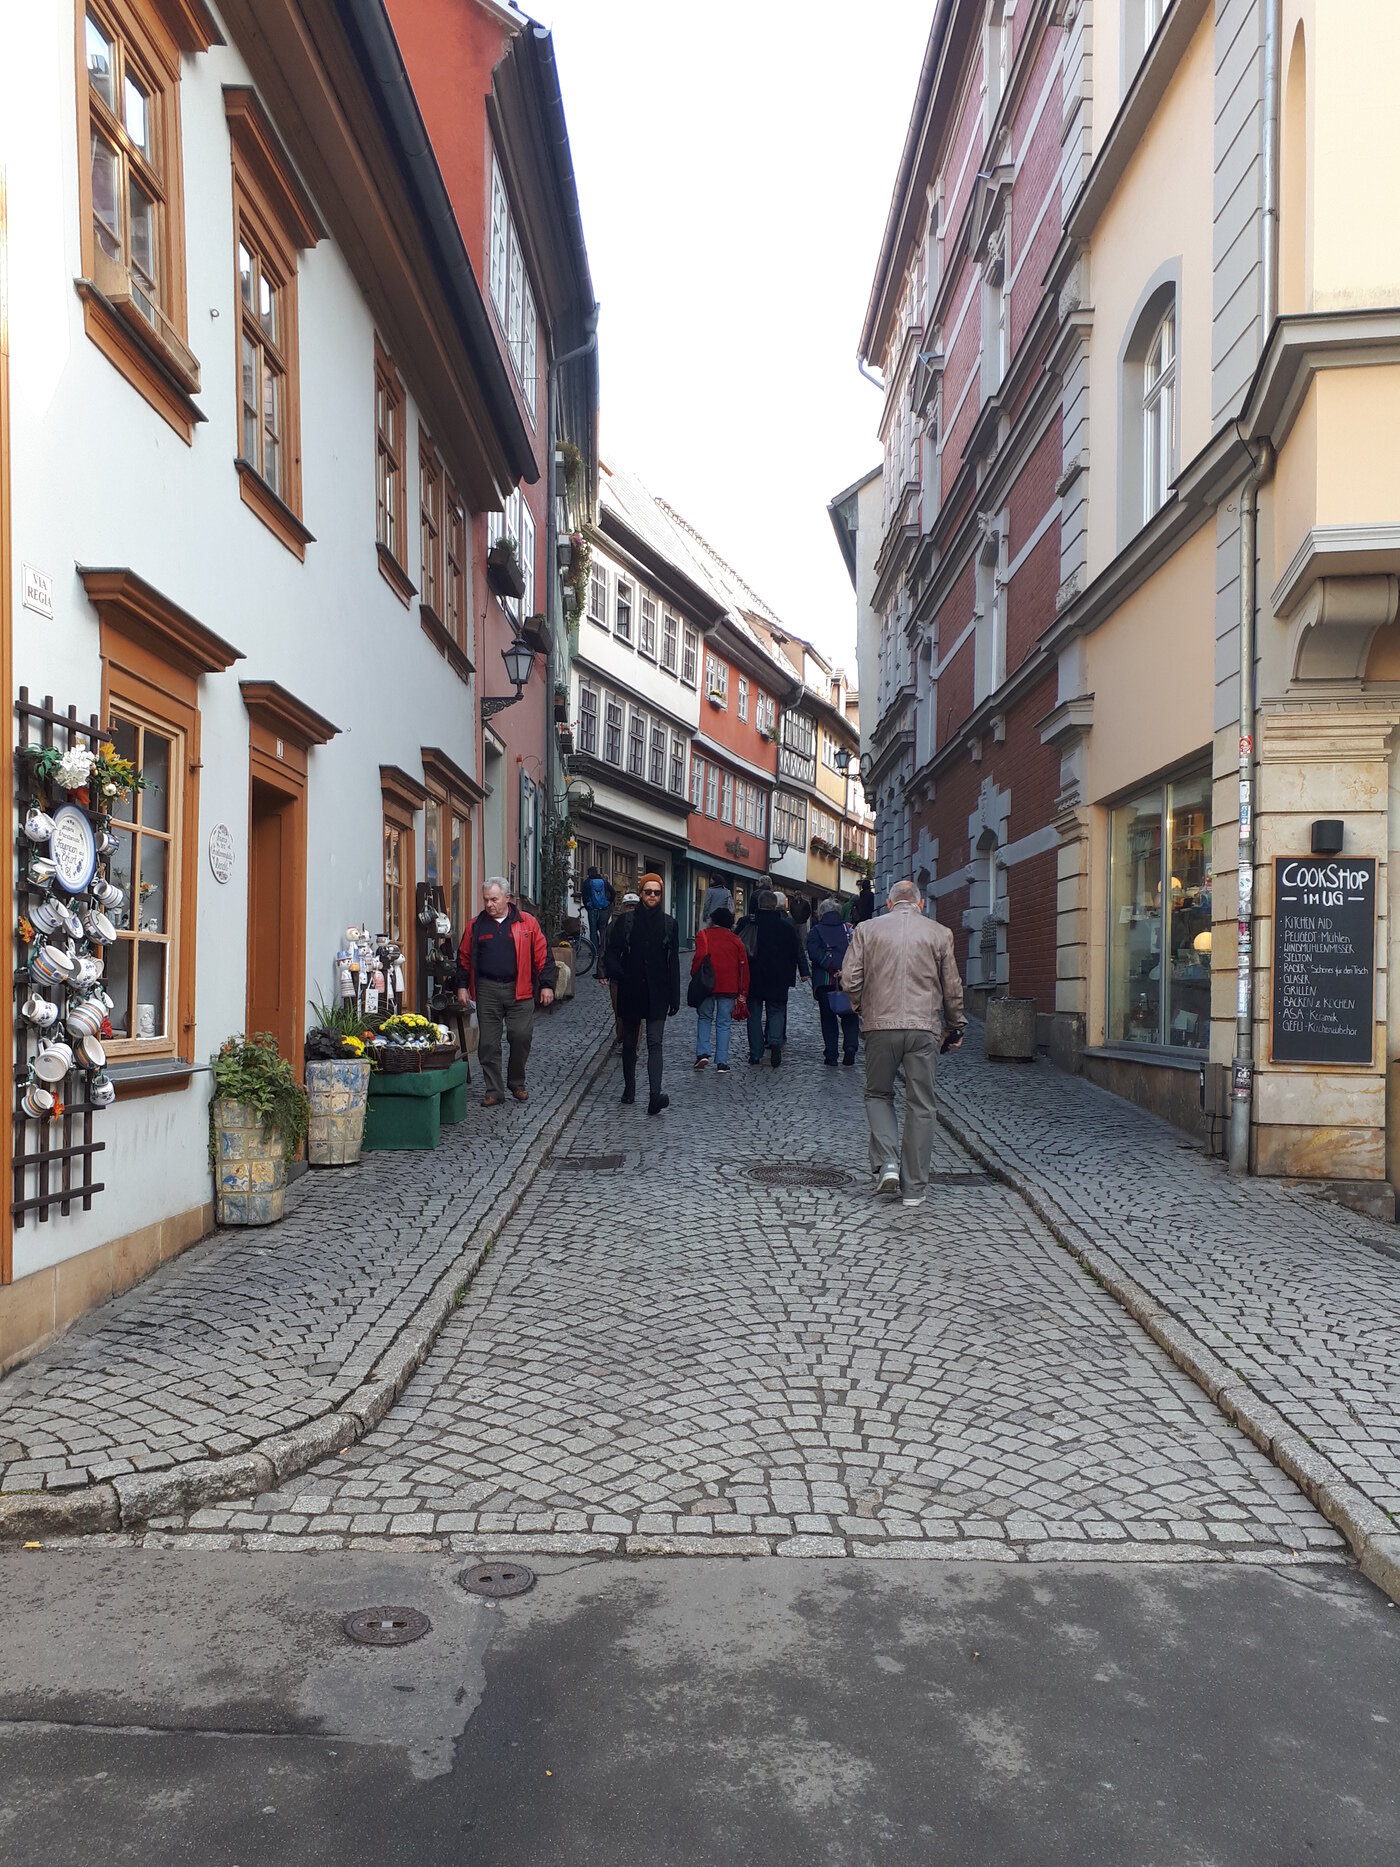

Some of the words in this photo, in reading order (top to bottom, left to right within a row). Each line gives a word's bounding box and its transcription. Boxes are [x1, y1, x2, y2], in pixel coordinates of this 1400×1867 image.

[33, 573, 48, 591] VIA
[28, 586, 53, 608] REGIA
[1322, 890, 1344, 907] UG
[1284, 915, 1315, 930] KITCHEN
[1283, 953, 1313, 962] STELTON
[1343, 965, 1353, 974] den
[1352, 965, 1369, 975] Tisch
[1283, 985, 1317, 996] GRILLEN
[1283, 996, 1314, 1008] BACKEN
[1323, 998, 1356, 1010] KOCHEN
[1282, 1008, 1304, 1020] ASA
